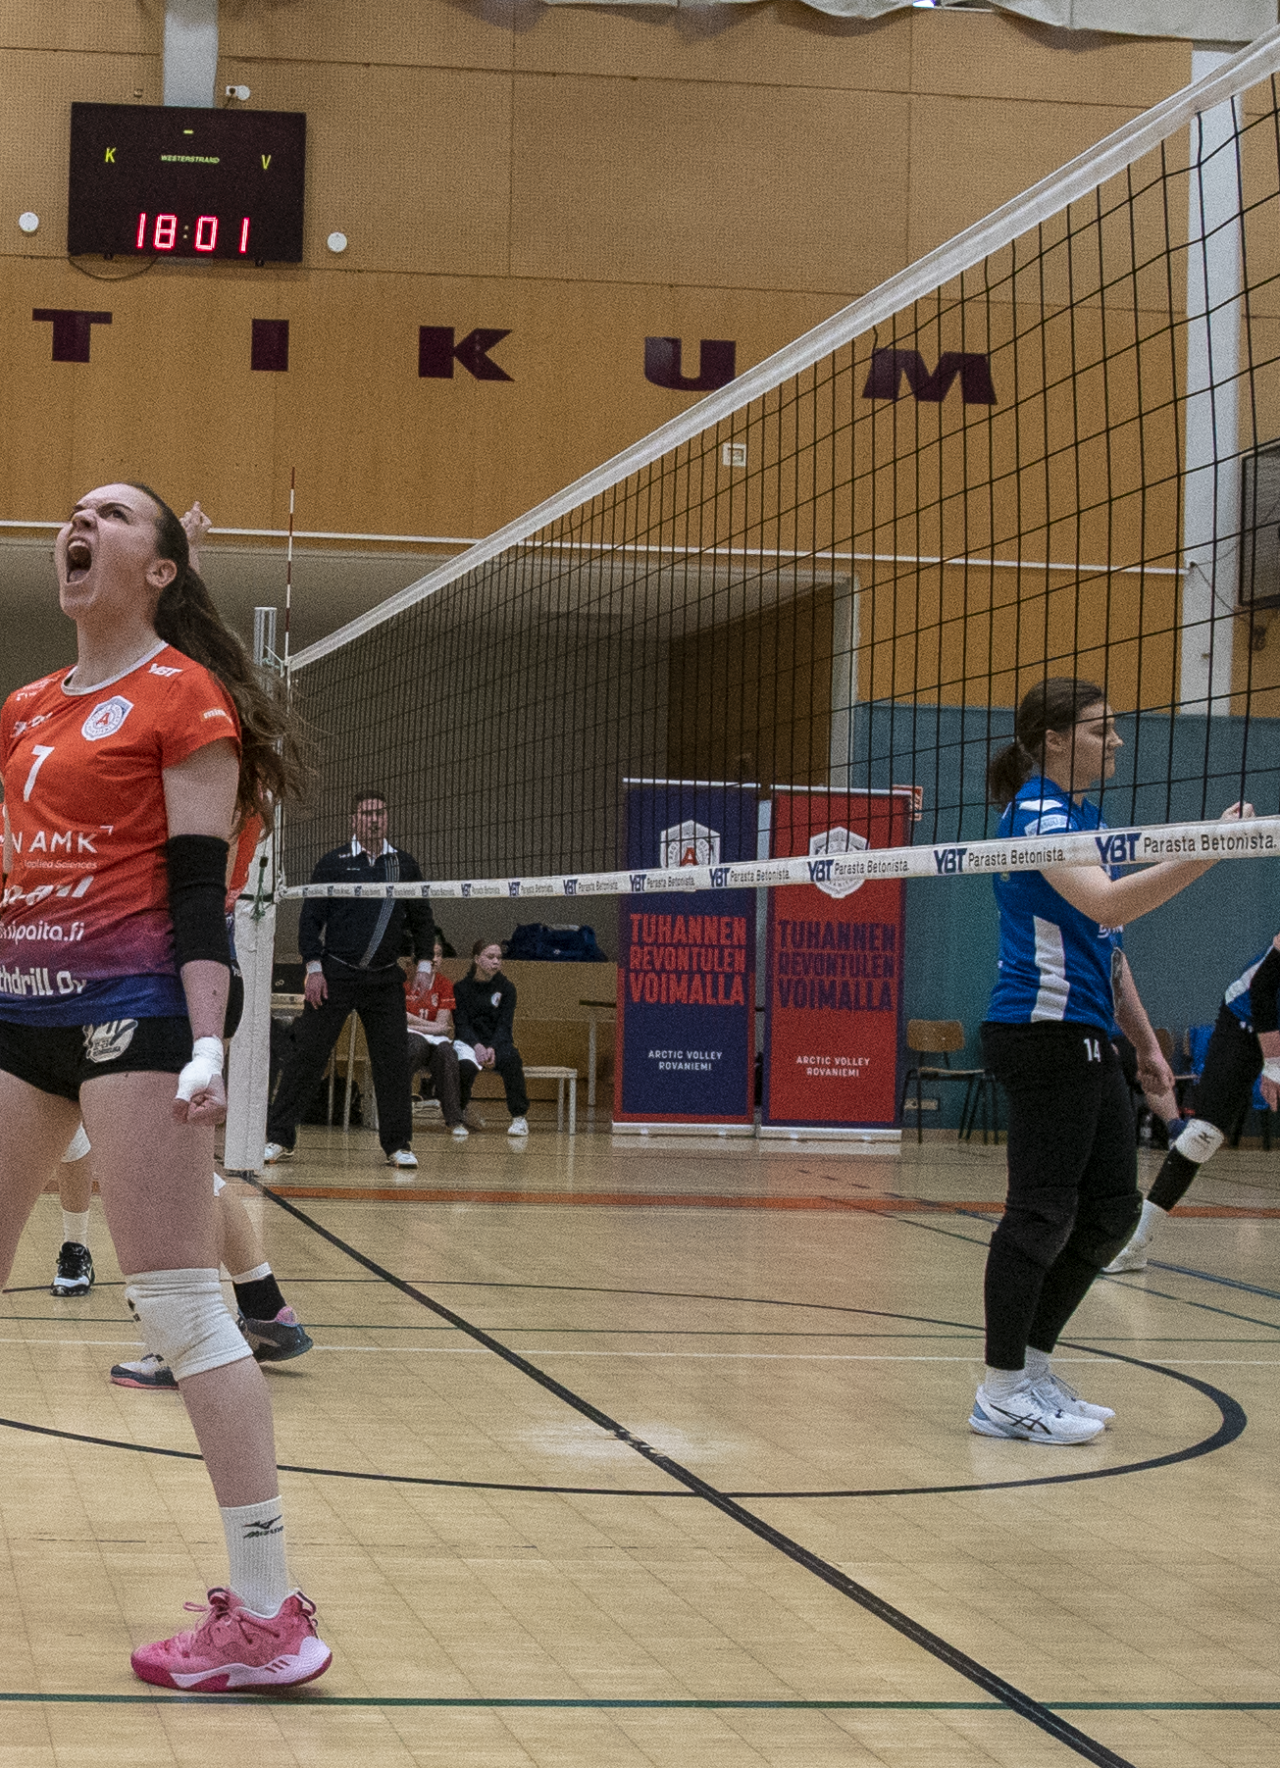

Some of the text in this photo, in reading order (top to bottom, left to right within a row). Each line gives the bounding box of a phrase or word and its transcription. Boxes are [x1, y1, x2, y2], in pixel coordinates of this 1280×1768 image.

[105, 147, 116, 163] K
[261, 154, 272, 169] V
[136, 212, 250, 253] 18:01
[23, 744, 56, 803] 7
[28, 830, 98, 854] AMK
[1095, 832, 1278, 864] YBT Parasta Betonista.
[807, 858, 910, 882] YBT Parasta Betonista.
[933, 847, 1066, 875] YBT Parasta Betonista.
[563, 879, 578, 895] YBT
[629, 874, 647, 892] YBT
[647, 877, 666, 888] Parasta
[709, 867, 731, 887] YBT
[730, 870, 755, 882] Parasta
[630, 913, 747, 946] TUHANNEN
[778, 920, 895, 952] TUHANNEN
[629, 945, 747, 973] REVONTULEN
[629, 972, 745, 1006] VOIMALLA
[648, 1049, 723, 1060] ARCTIC VOLLEY
[796, 1055, 871, 1066] ARCTIC VOLLEY
[1083, 1038, 1102, 1063] 14
[659, 1061, 713, 1071] ROVANIEMI
[806, 1067, 860, 1077] ROVANIEMI
